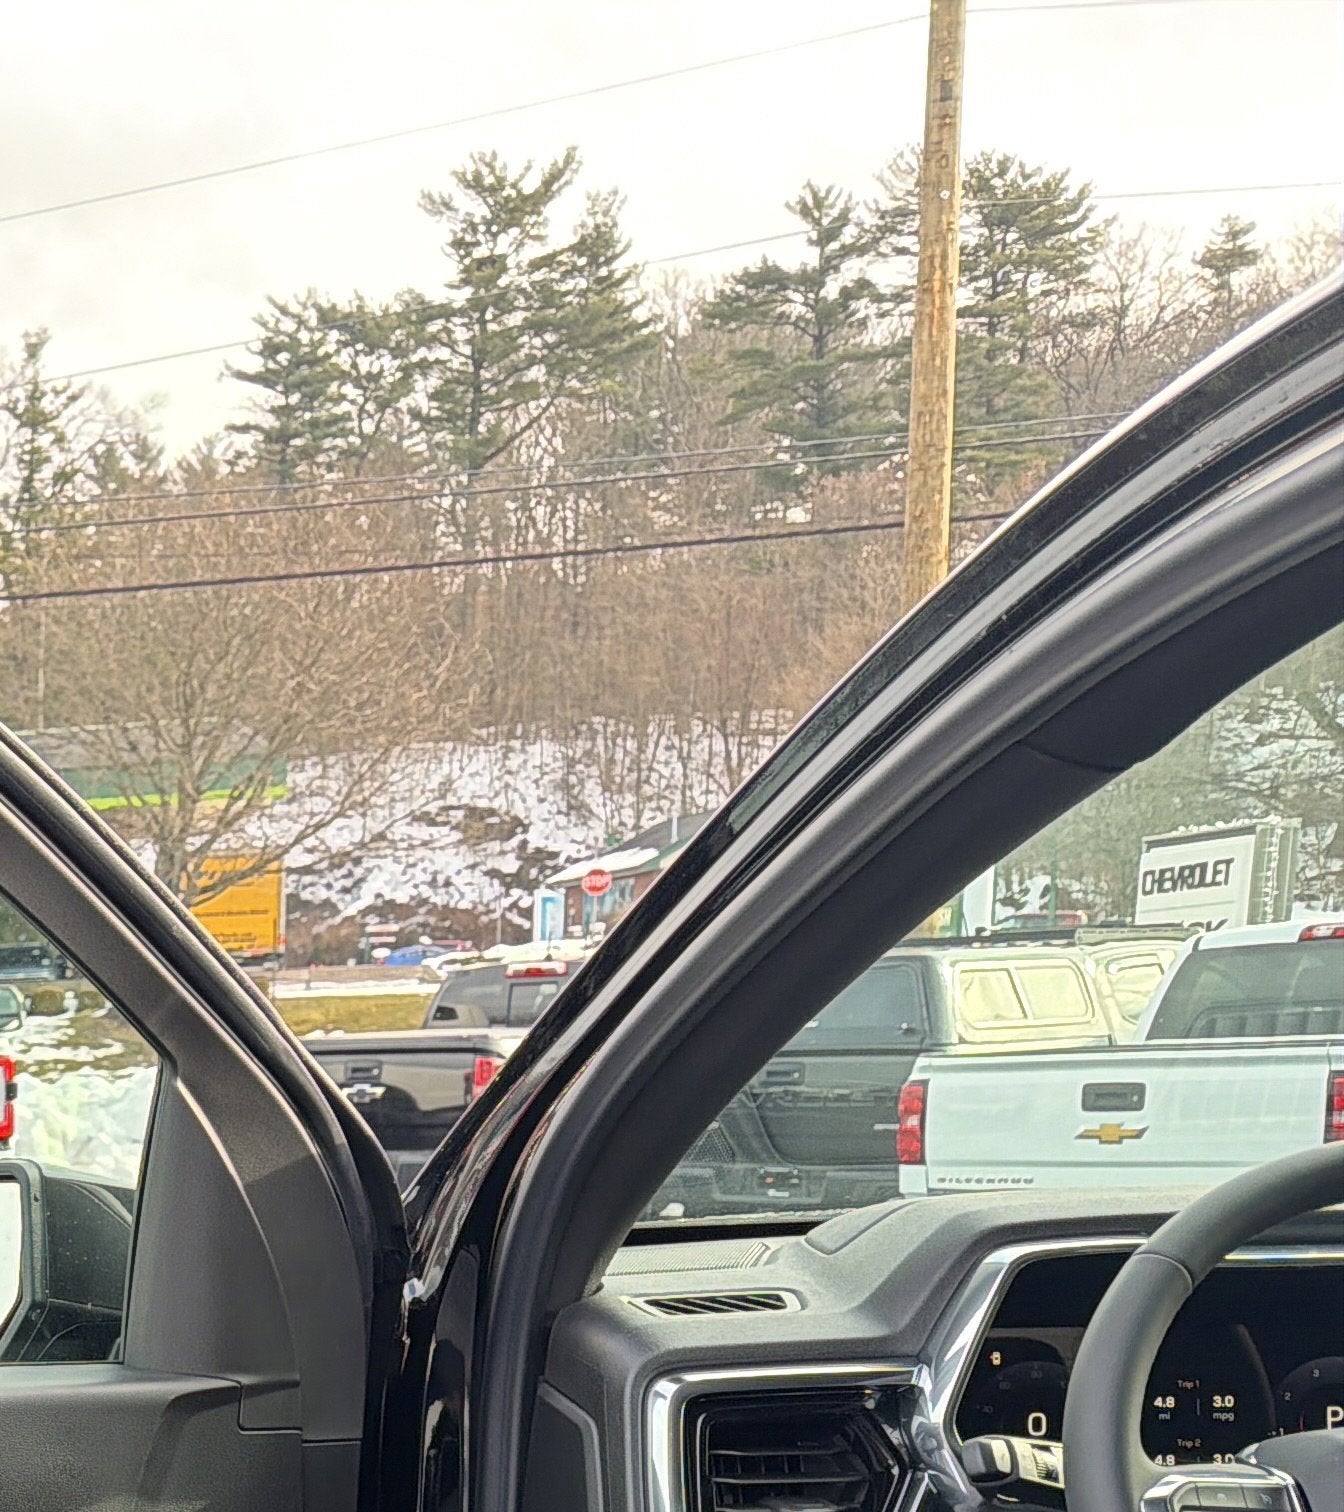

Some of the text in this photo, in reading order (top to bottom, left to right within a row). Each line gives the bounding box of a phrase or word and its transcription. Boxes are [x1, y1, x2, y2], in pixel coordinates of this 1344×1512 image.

[1142, 857, 1234, 896] CHEVROLET
[1177, 1380, 1193, 1389] Trip
[1154, 1396, 1175, 1408] 4.8
[1212, 1395, 1234, 1408] 3.0
[1159, 1412, 1170, 1420] mi
[1213, 1412, 1234, 1421] mpg
[1327, 1406, 1344, 1430] P
[1177, 1439, 1201, 1448] Trip 2
[1155, 1454, 1175, 1466] 4.8
